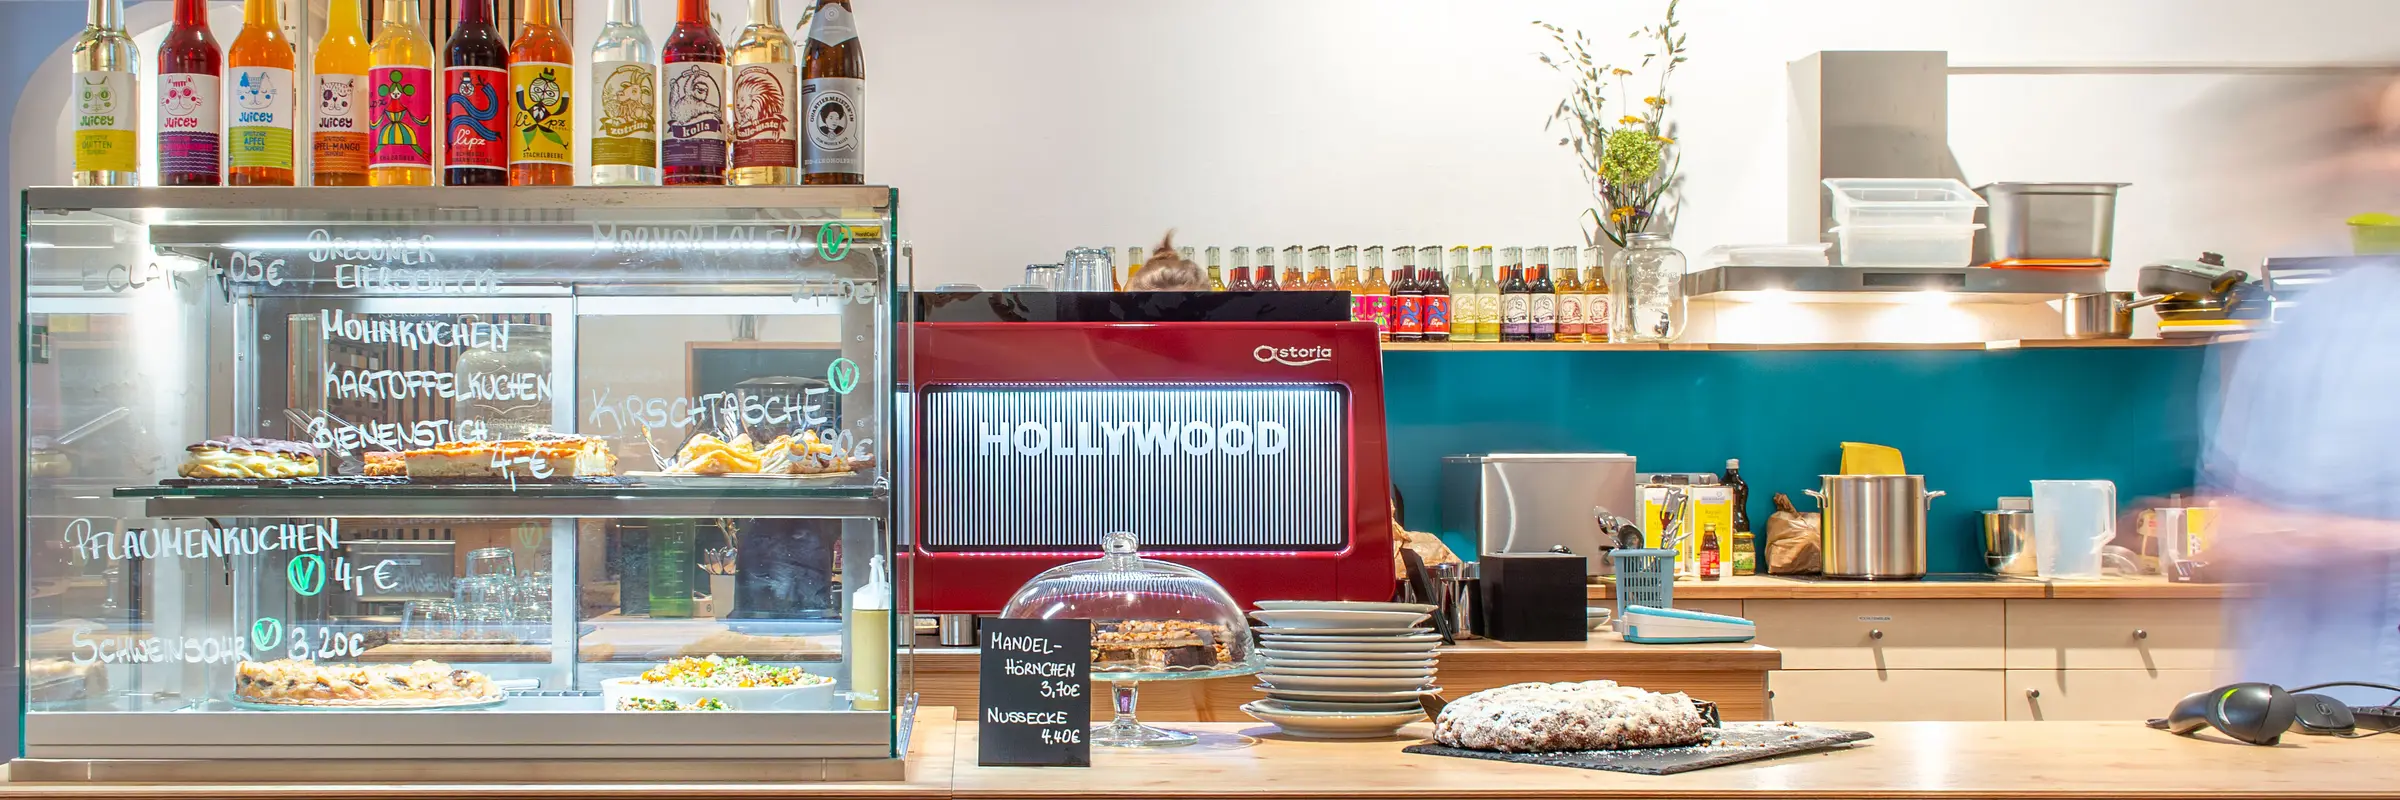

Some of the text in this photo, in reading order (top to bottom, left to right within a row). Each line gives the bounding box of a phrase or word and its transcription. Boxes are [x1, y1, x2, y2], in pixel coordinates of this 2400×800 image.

[682, 123, 711, 138] kolla
[321, 309, 510, 352] MOHNKUCHEN
[325, 362, 553, 402] KARTOFFELKUCHEN
[588, 387, 830, 432] KIRSCHTASCHE
[307, 417, 488, 450] BIENENSTICH
[979, 420, 1288, 457] HOLLYWOOD
[64, 517, 338, 560] PFLAUMENKUCHEN
[71, 628, 253, 665] SCHWEINSOHR
[287, 627, 365, 662] 3,20€
[991, 632, 1062, 654] MANDEL-
[1004, 658, 1075, 677] HÖRNCHEN
[1040, 680, 1080, 698] 3,70€
[987, 706, 1068, 725] NUSSECKE
